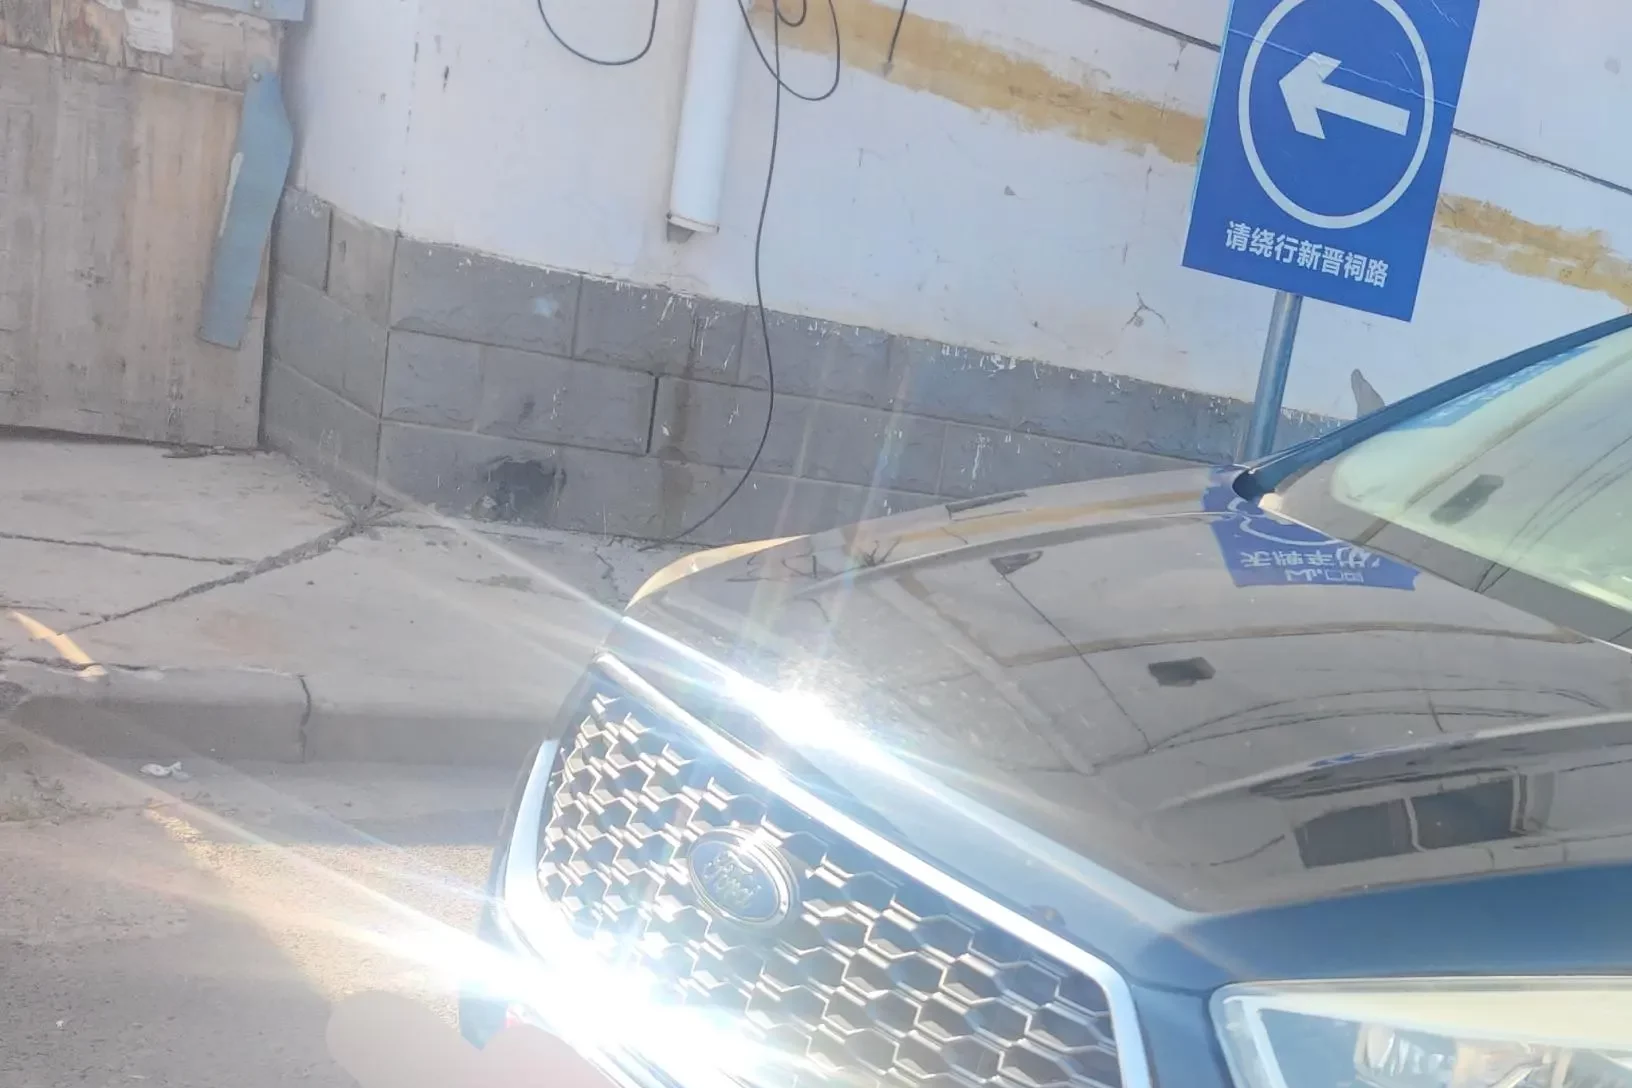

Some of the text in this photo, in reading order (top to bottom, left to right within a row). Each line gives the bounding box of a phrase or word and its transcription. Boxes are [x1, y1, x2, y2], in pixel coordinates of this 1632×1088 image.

[1225, 220, 1389, 288] 请绕行新晋祠路
